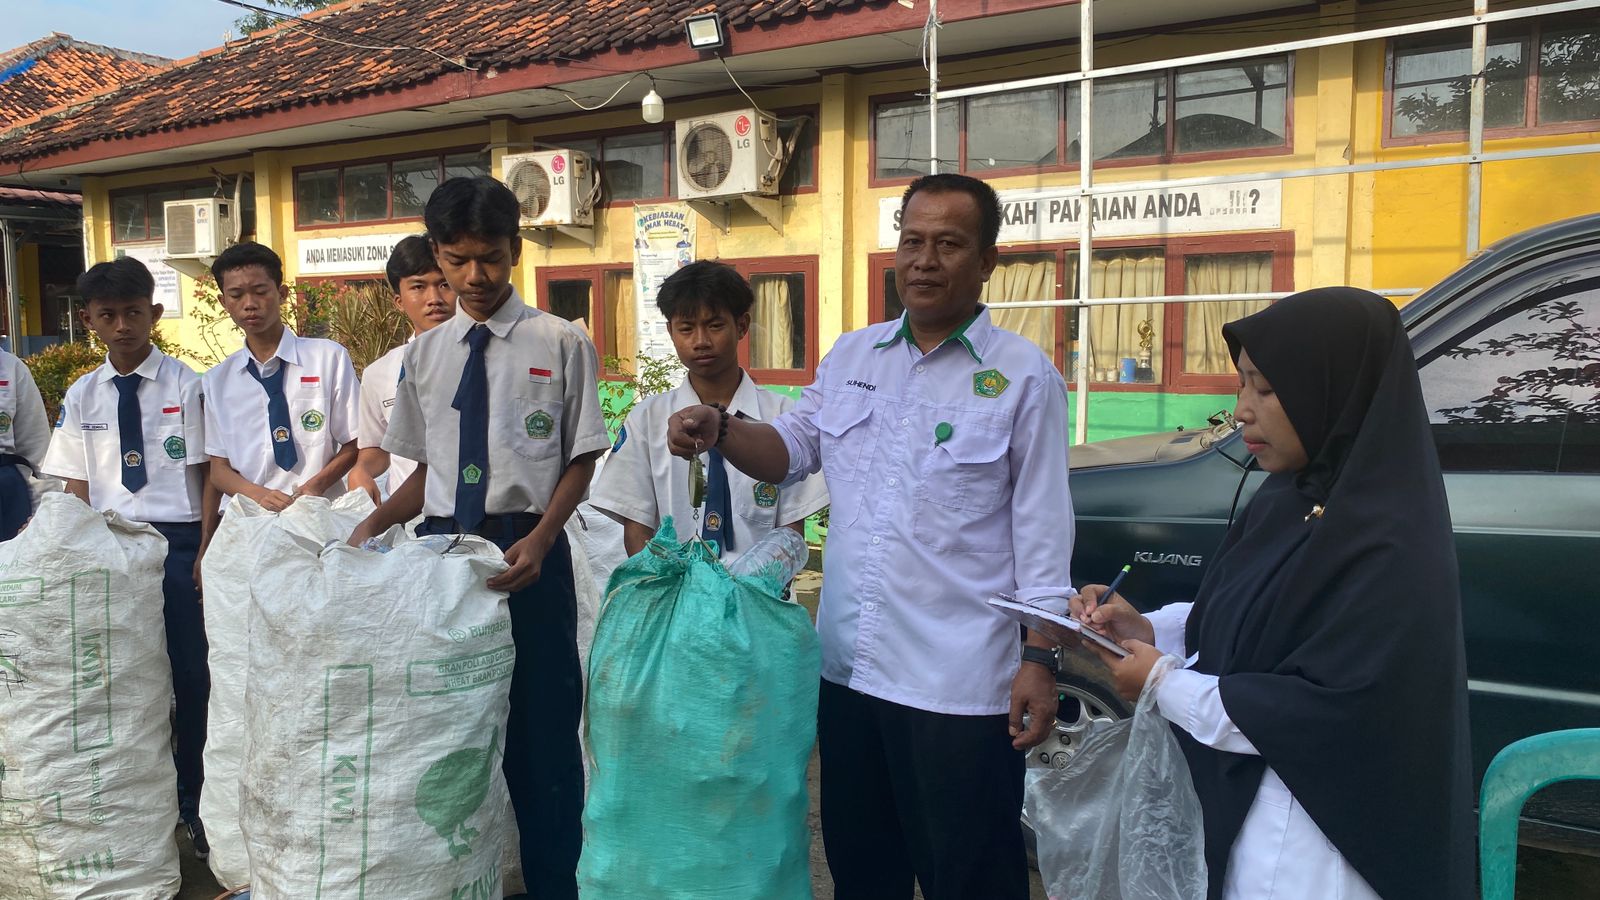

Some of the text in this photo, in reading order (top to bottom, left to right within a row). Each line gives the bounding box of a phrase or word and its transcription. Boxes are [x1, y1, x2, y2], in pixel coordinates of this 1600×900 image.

[737, 139, 750, 149] LG
[553, 176, 565, 186] LG
[1143, 192, 1202, 219] ANDA
[643, 211, 685, 223] KEBIASAAN
[306, 248, 325, 264] ANDA
[326, 246, 365, 263] MEMASUKI
[366, 245, 388, 261] ZONA
[846, 379, 877, 392] SUHENDI
[81, 632, 102, 689] KIWI
[331, 754, 358, 824] KIWI
